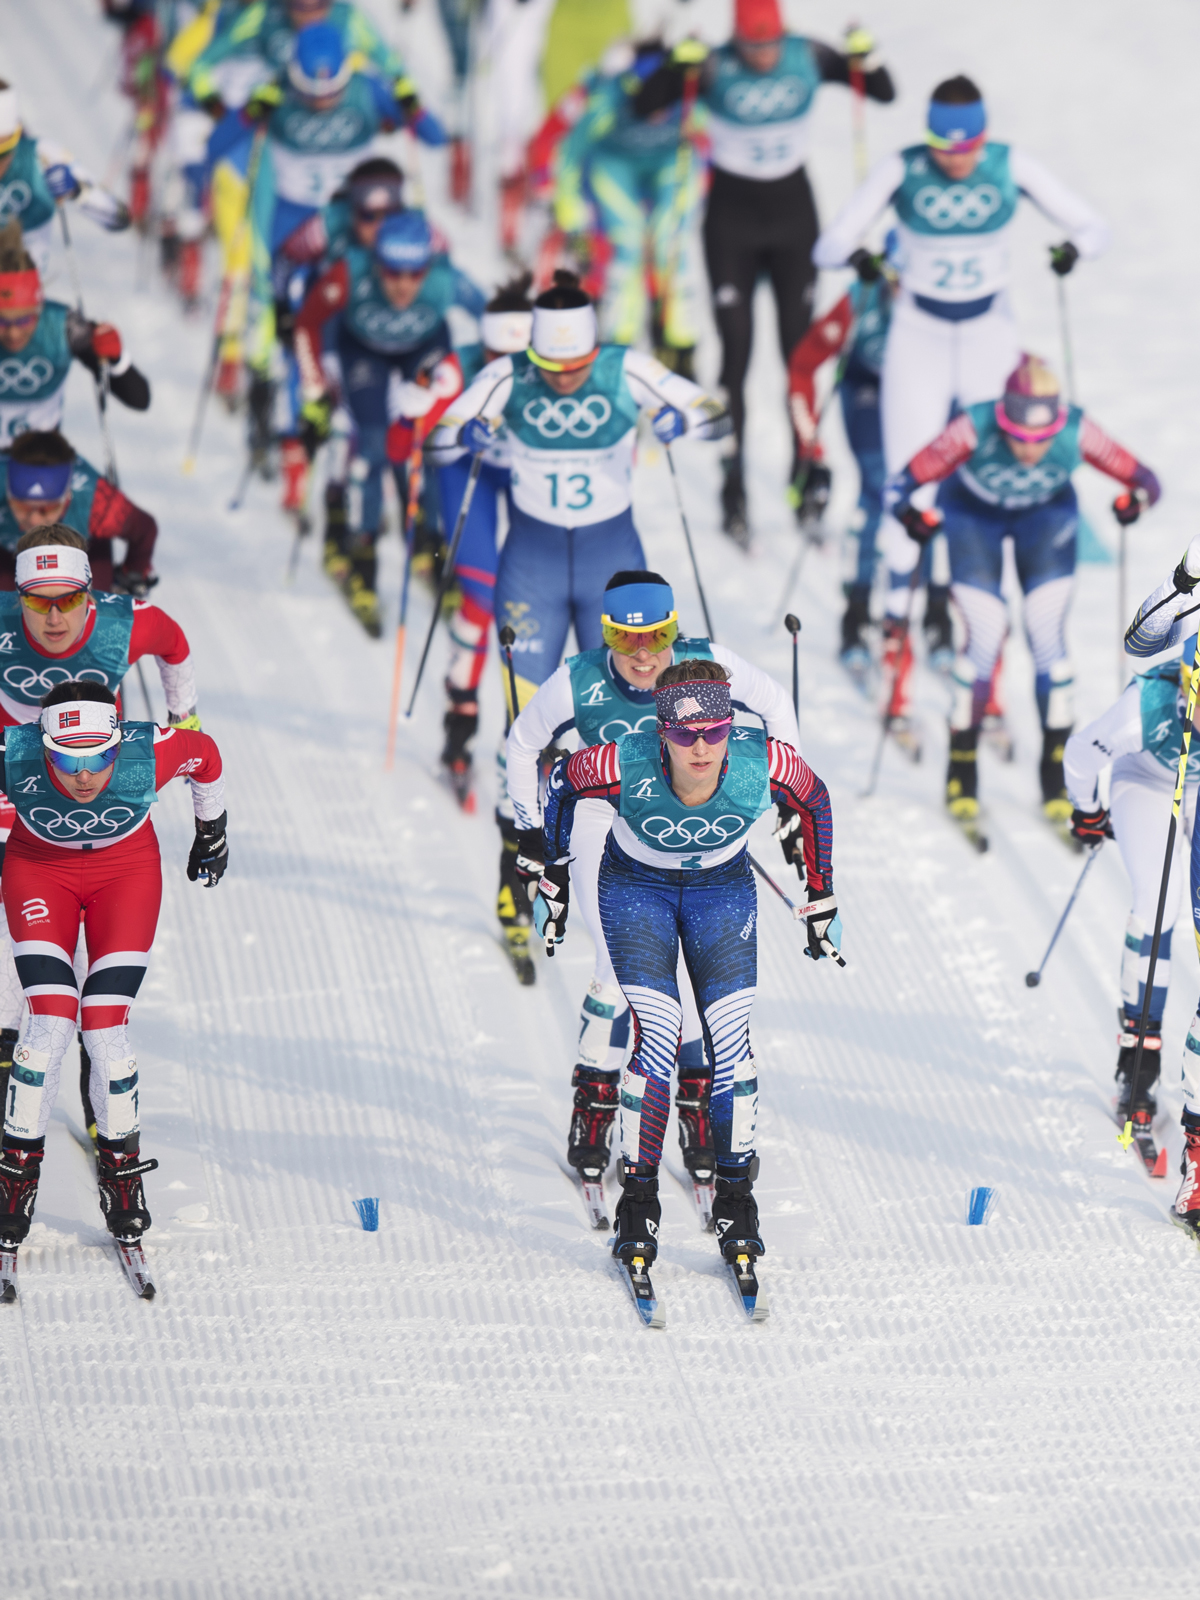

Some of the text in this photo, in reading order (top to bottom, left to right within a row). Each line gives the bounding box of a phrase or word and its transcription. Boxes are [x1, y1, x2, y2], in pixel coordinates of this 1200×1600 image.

[931, 259, 984, 290] 25
[545, 473, 594, 511] 13
[9, 1084, 17, 1118] 1
